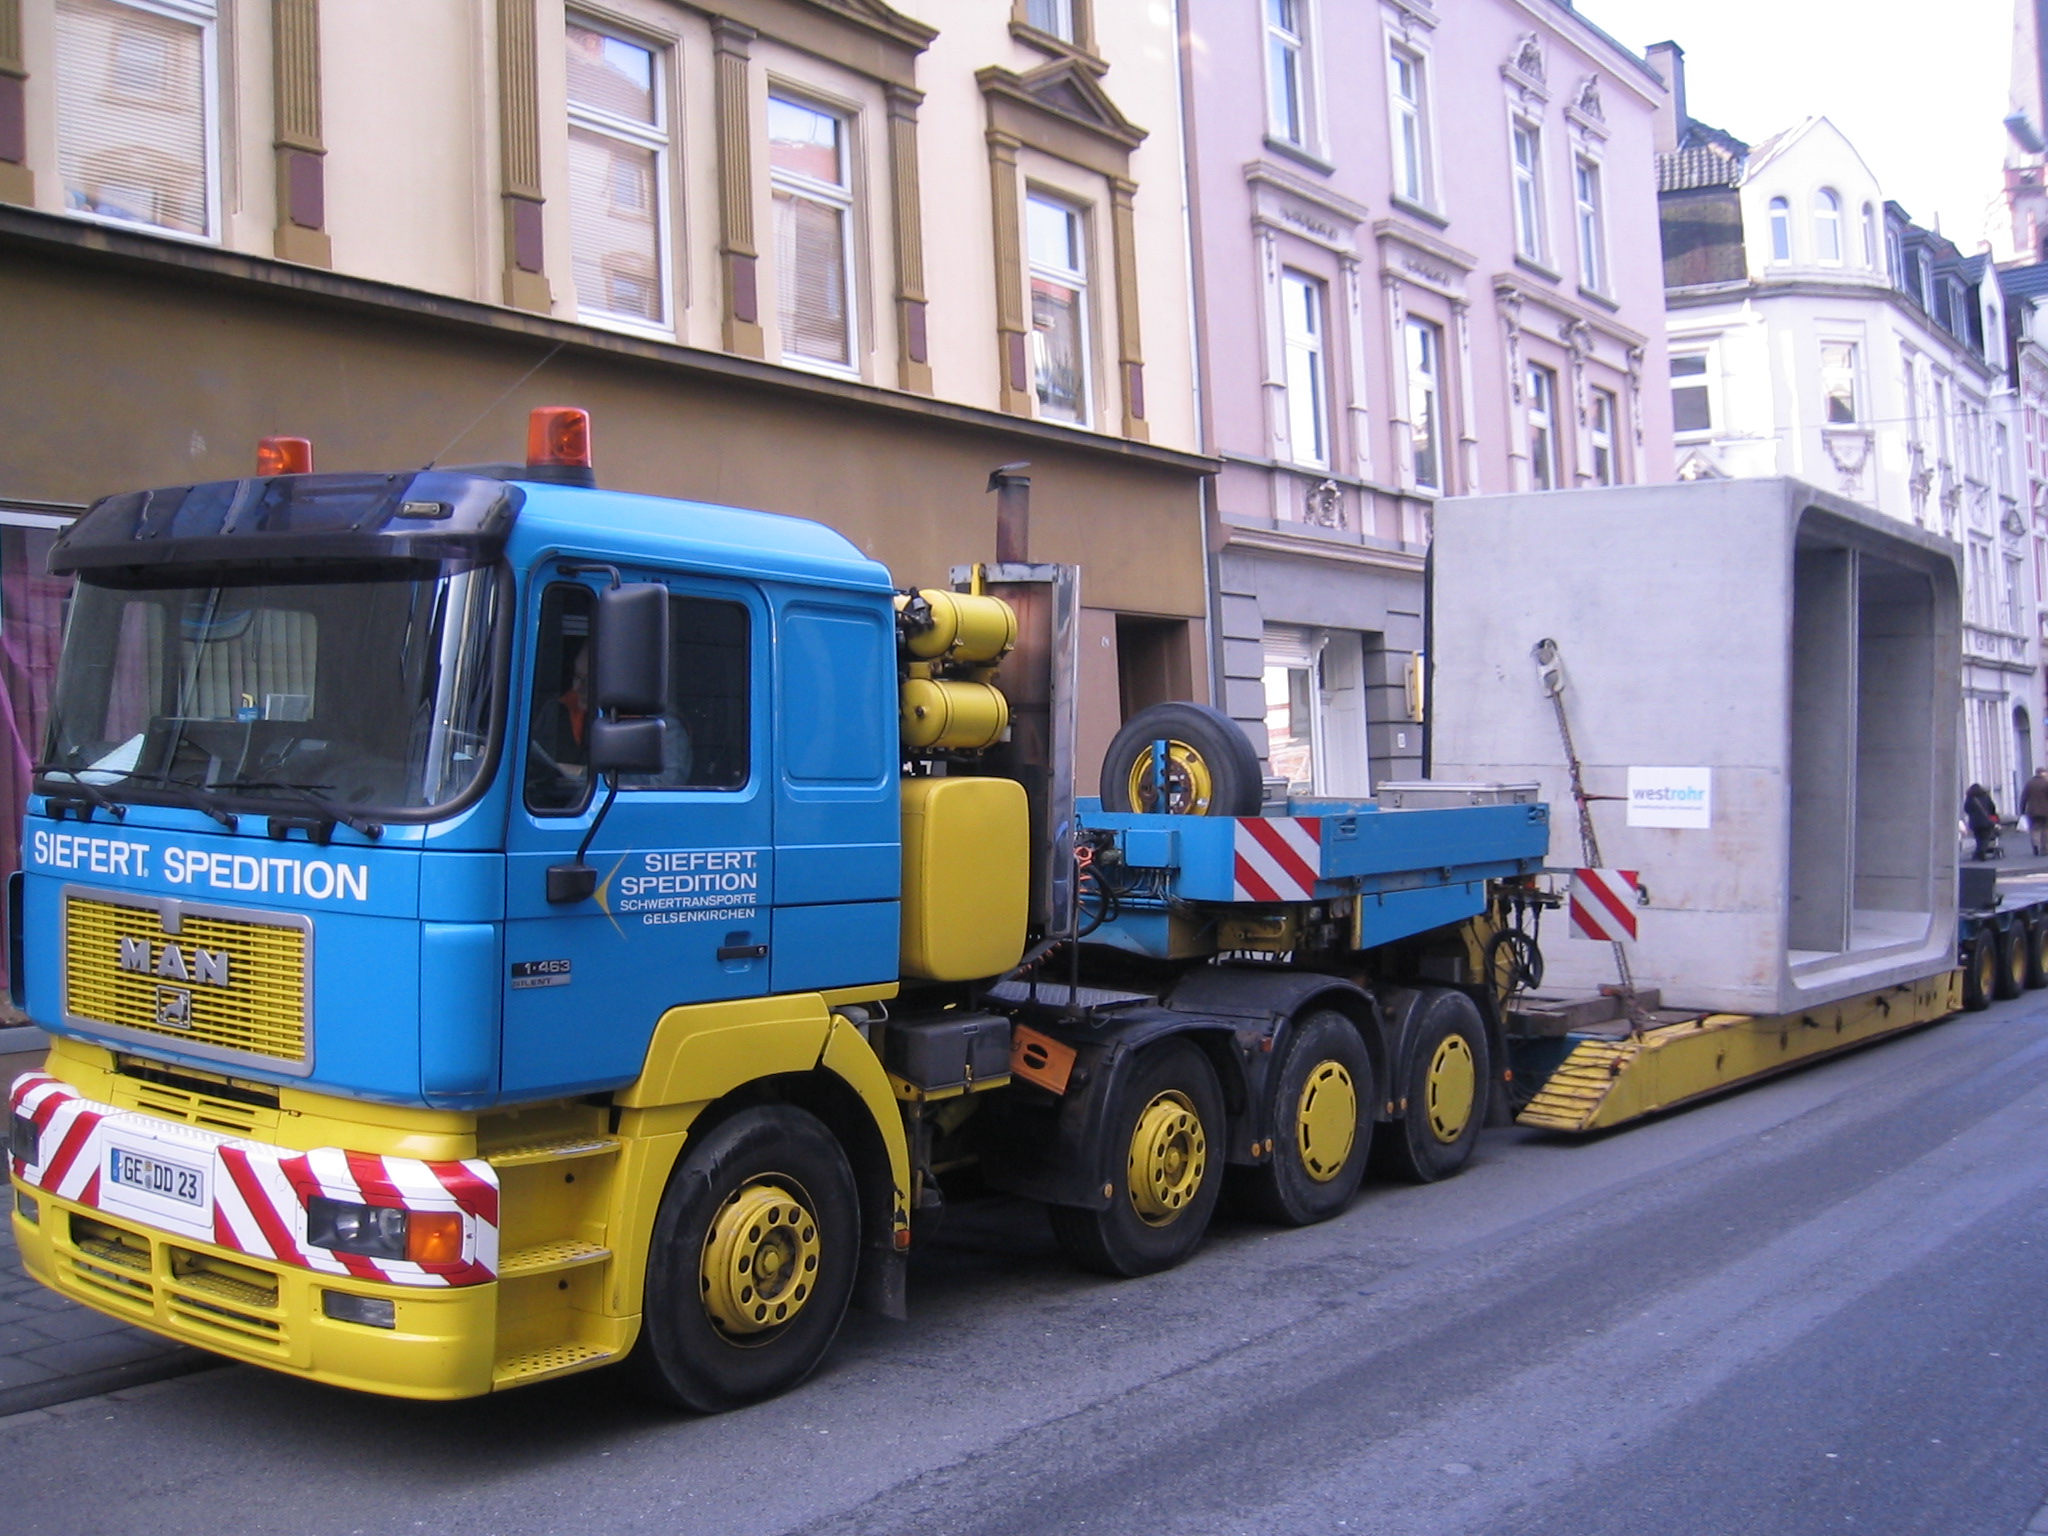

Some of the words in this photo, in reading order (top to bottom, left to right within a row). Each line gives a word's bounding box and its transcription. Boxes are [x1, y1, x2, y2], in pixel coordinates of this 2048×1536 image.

[1632, 786, 1705, 801] westrohr
[34, 831, 149, 877] SIEFERT
[164, 847, 368, 900] SPEDITION
[645, 852, 757, 872] SIEFERT
[621, 873, 757, 895] SPEDITION
[620, 893, 757, 911] SCHWERTRANSPORTE
[643, 909, 755, 925] GELSENKIRCHEN
[121, 937, 230, 986] MAN
[124, 1156, 143, 1185] GE
[154, 1164, 173, 1192] DD
[178, 1171, 197, 1200] 23
